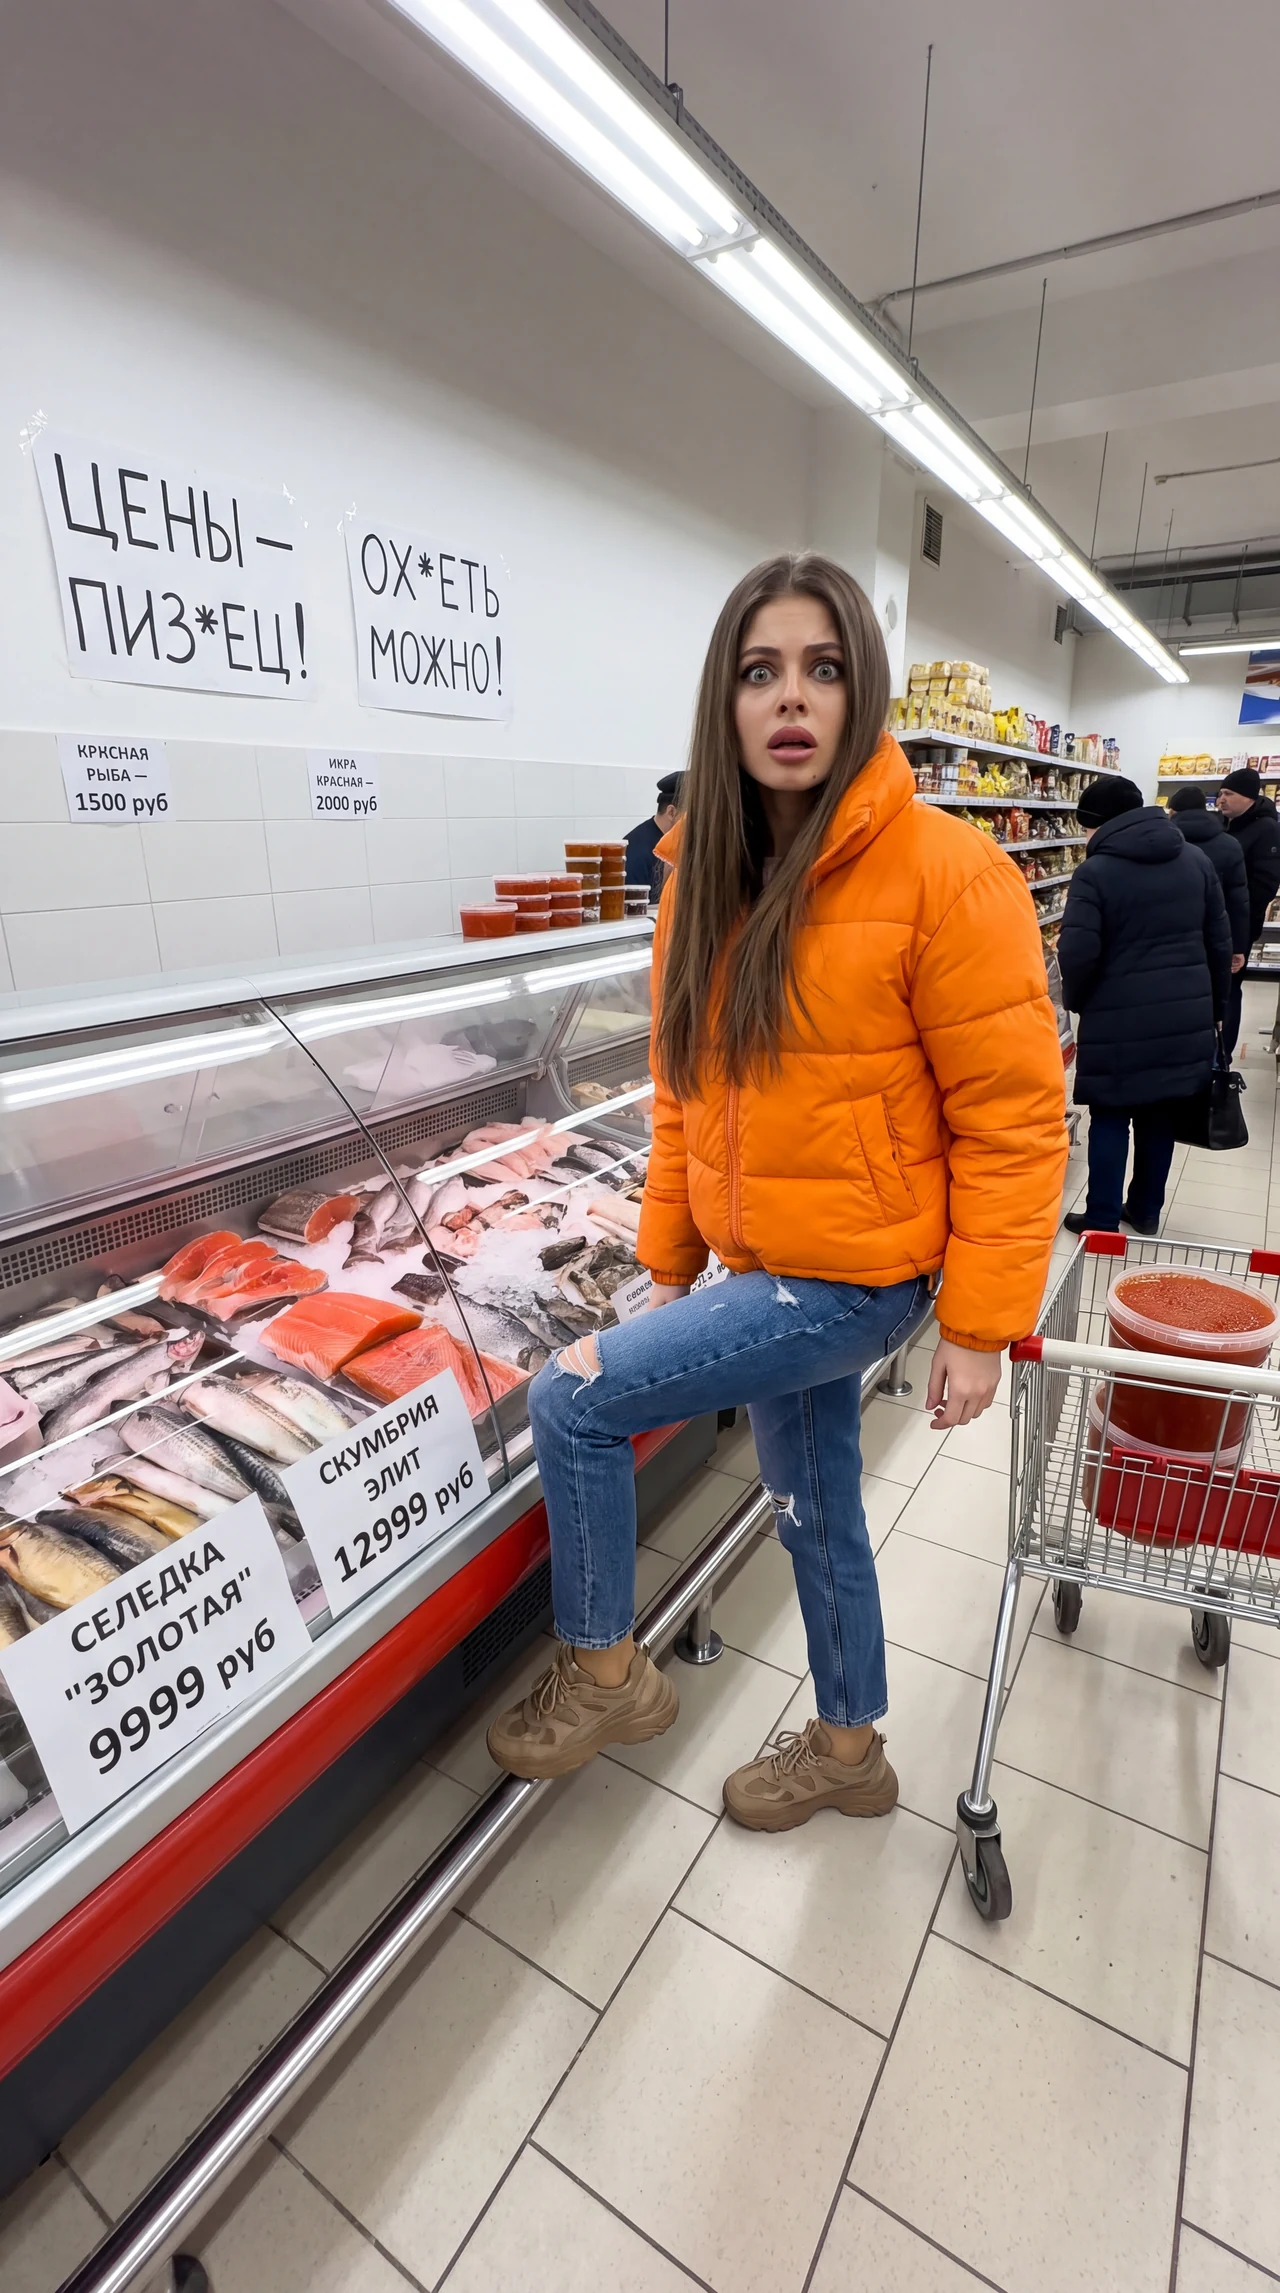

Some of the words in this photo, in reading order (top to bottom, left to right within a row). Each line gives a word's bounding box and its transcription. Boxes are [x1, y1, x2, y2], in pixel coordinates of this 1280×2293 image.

[54, 452, 244, 568] ЦЕНЫ
[370, 625, 502, 697] МОЖНО!
[77, 744, 149, 761] КРКСНАЯ
[86, 767, 132, 782] РЫБА
[316, 775, 363, 788] КРАСНАЯ
[328, 758, 357, 770] ИКРА
[75, 792, 127, 811] 1500
[132, 792, 168, 817] руб
[316, 795, 350, 811] 2000
[353, 795, 378, 815] руб
[319, 1394, 440, 1485] СКУМБРИЯ
[363, 1446, 421, 1502] ЭЛИТ
[334, 1491, 428, 1583] 12999
[434, 1461, 475, 1516] руб
[70, 1541, 226, 1653] СЕЛЕДКА
[64, 1566, 252, 1705] "ЗОЛОТАЯ"
[88, 1665, 205, 1775] 9999
[216, 1616, 276, 1691] руб
